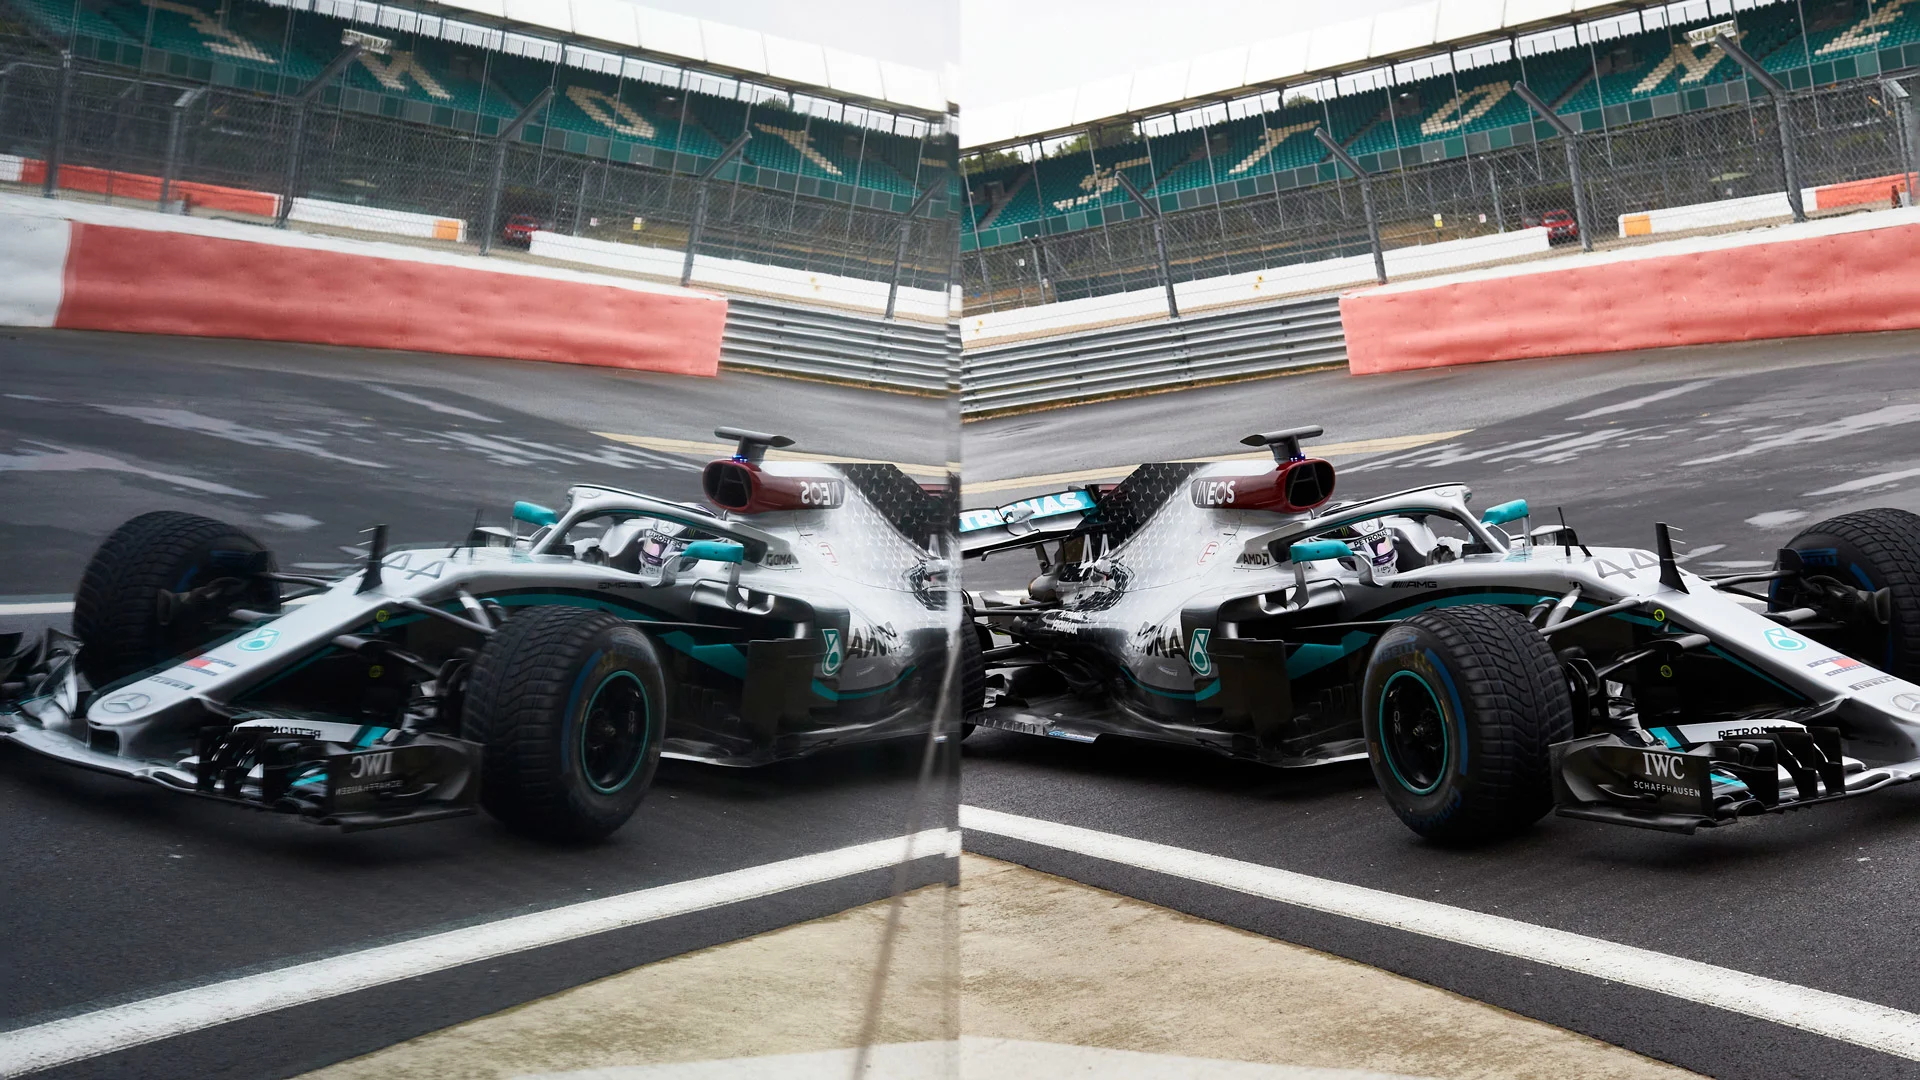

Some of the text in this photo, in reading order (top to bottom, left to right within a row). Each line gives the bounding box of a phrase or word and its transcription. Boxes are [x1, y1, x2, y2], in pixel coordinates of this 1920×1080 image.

[1195, 480, 1236, 505] INEOS
[1243, 553, 1264, 565] AMD
[1593, 551, 1687, 580] 44
[1405, 581, 1438, 589] AMG
[1643, 752, 1685, 780] IWC
[1633, 780, 1700, 797] SCHAFFHAUSEN
